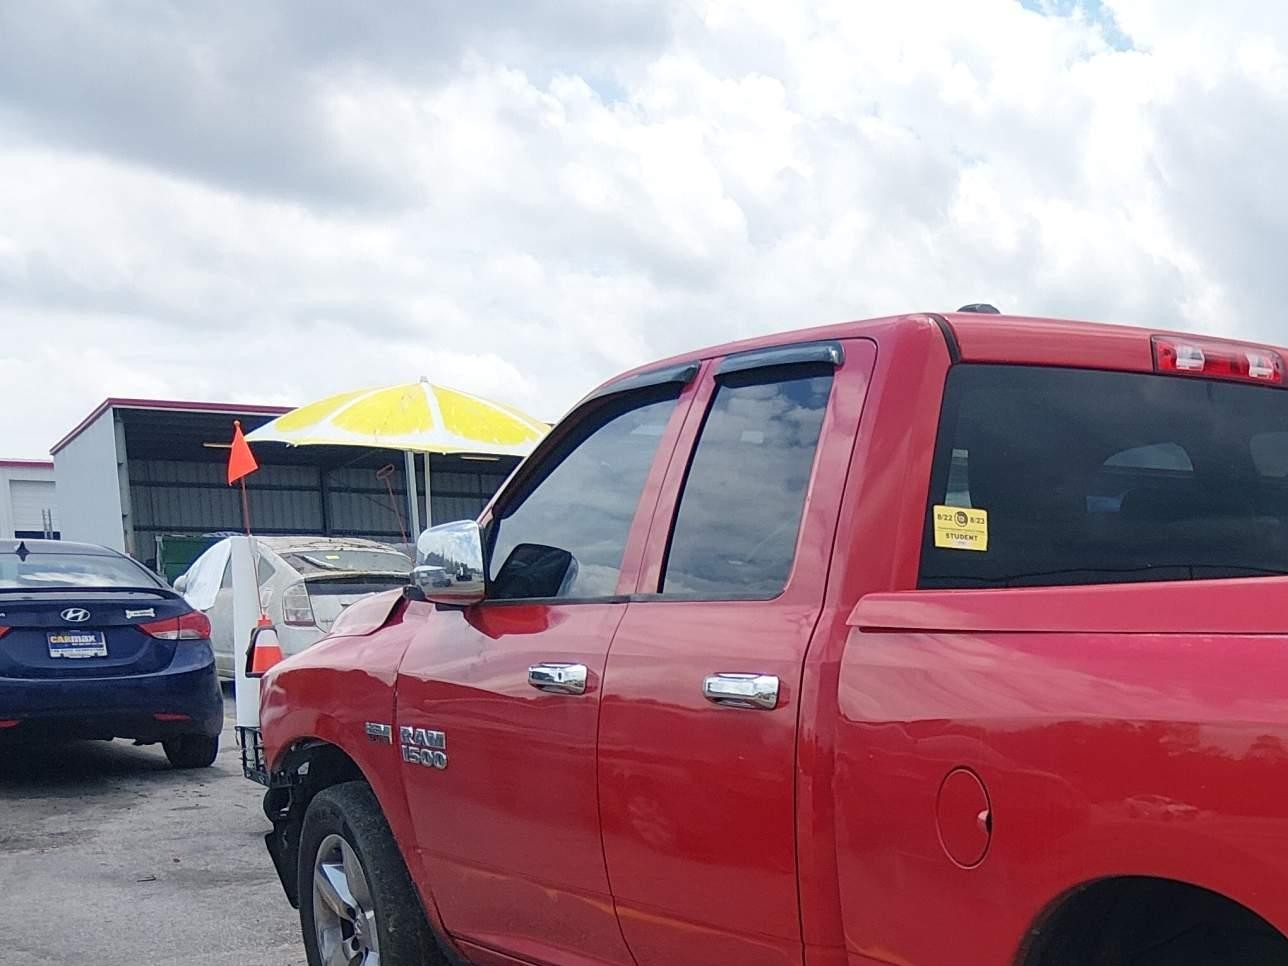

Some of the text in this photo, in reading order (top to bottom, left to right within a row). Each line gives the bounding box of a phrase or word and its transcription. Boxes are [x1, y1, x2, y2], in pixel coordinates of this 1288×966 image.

[945, 532, 978, 541] STUDENT
[399, 726, 446, 750] RAM
[401, 744, 448, 770] 1500
